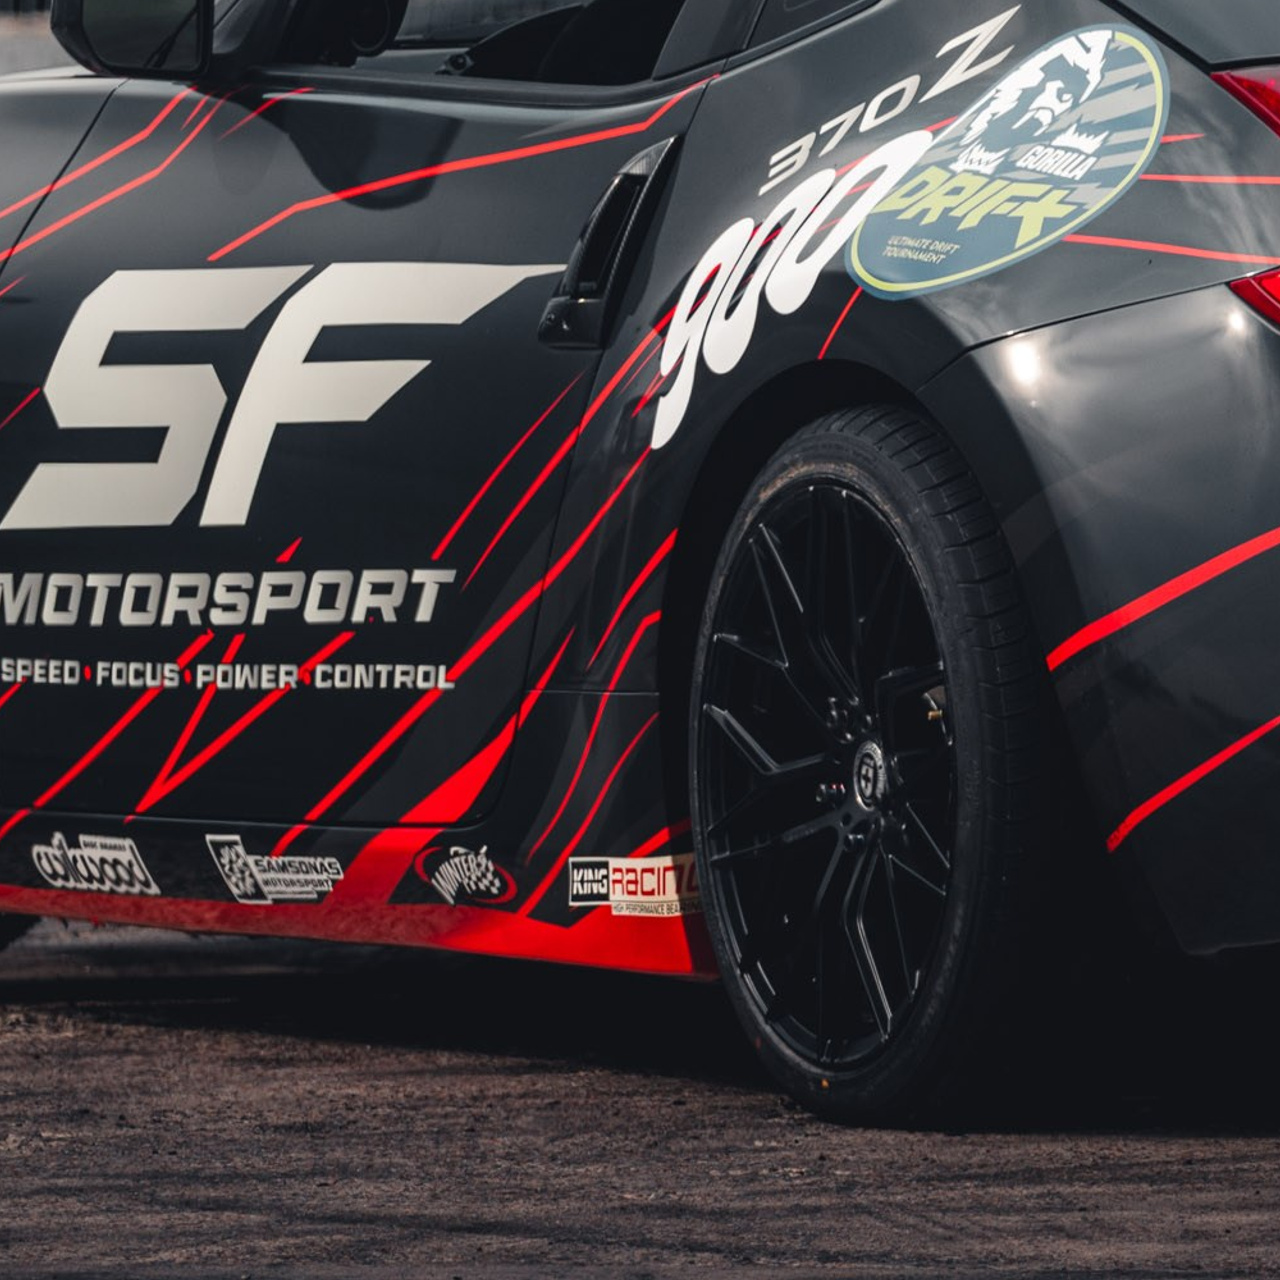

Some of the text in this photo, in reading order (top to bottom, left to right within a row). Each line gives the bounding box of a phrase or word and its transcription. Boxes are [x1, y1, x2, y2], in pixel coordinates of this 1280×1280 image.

[1017, 146, 1098, 180] GORILLA
[868, 164, 1081, 250] DRIFT
[882, 245, 947, 265] TOURNAMENT
[887, 235, 960, 254] ULTIMATE DRIFT
[0, 261, 568, 530] SF
[0, 569, 457, 626] MOTORSPORT
[1, 658, 455, 690] SPEED FOCUS POWER CONTROL
[254, 858, 341, 876] SAMSONAS
[262, 877, 331, 890] MOTORSPORT
[573, 868, 609, 896] KING
[626, 903, 665, 915] PERFORMANCE
